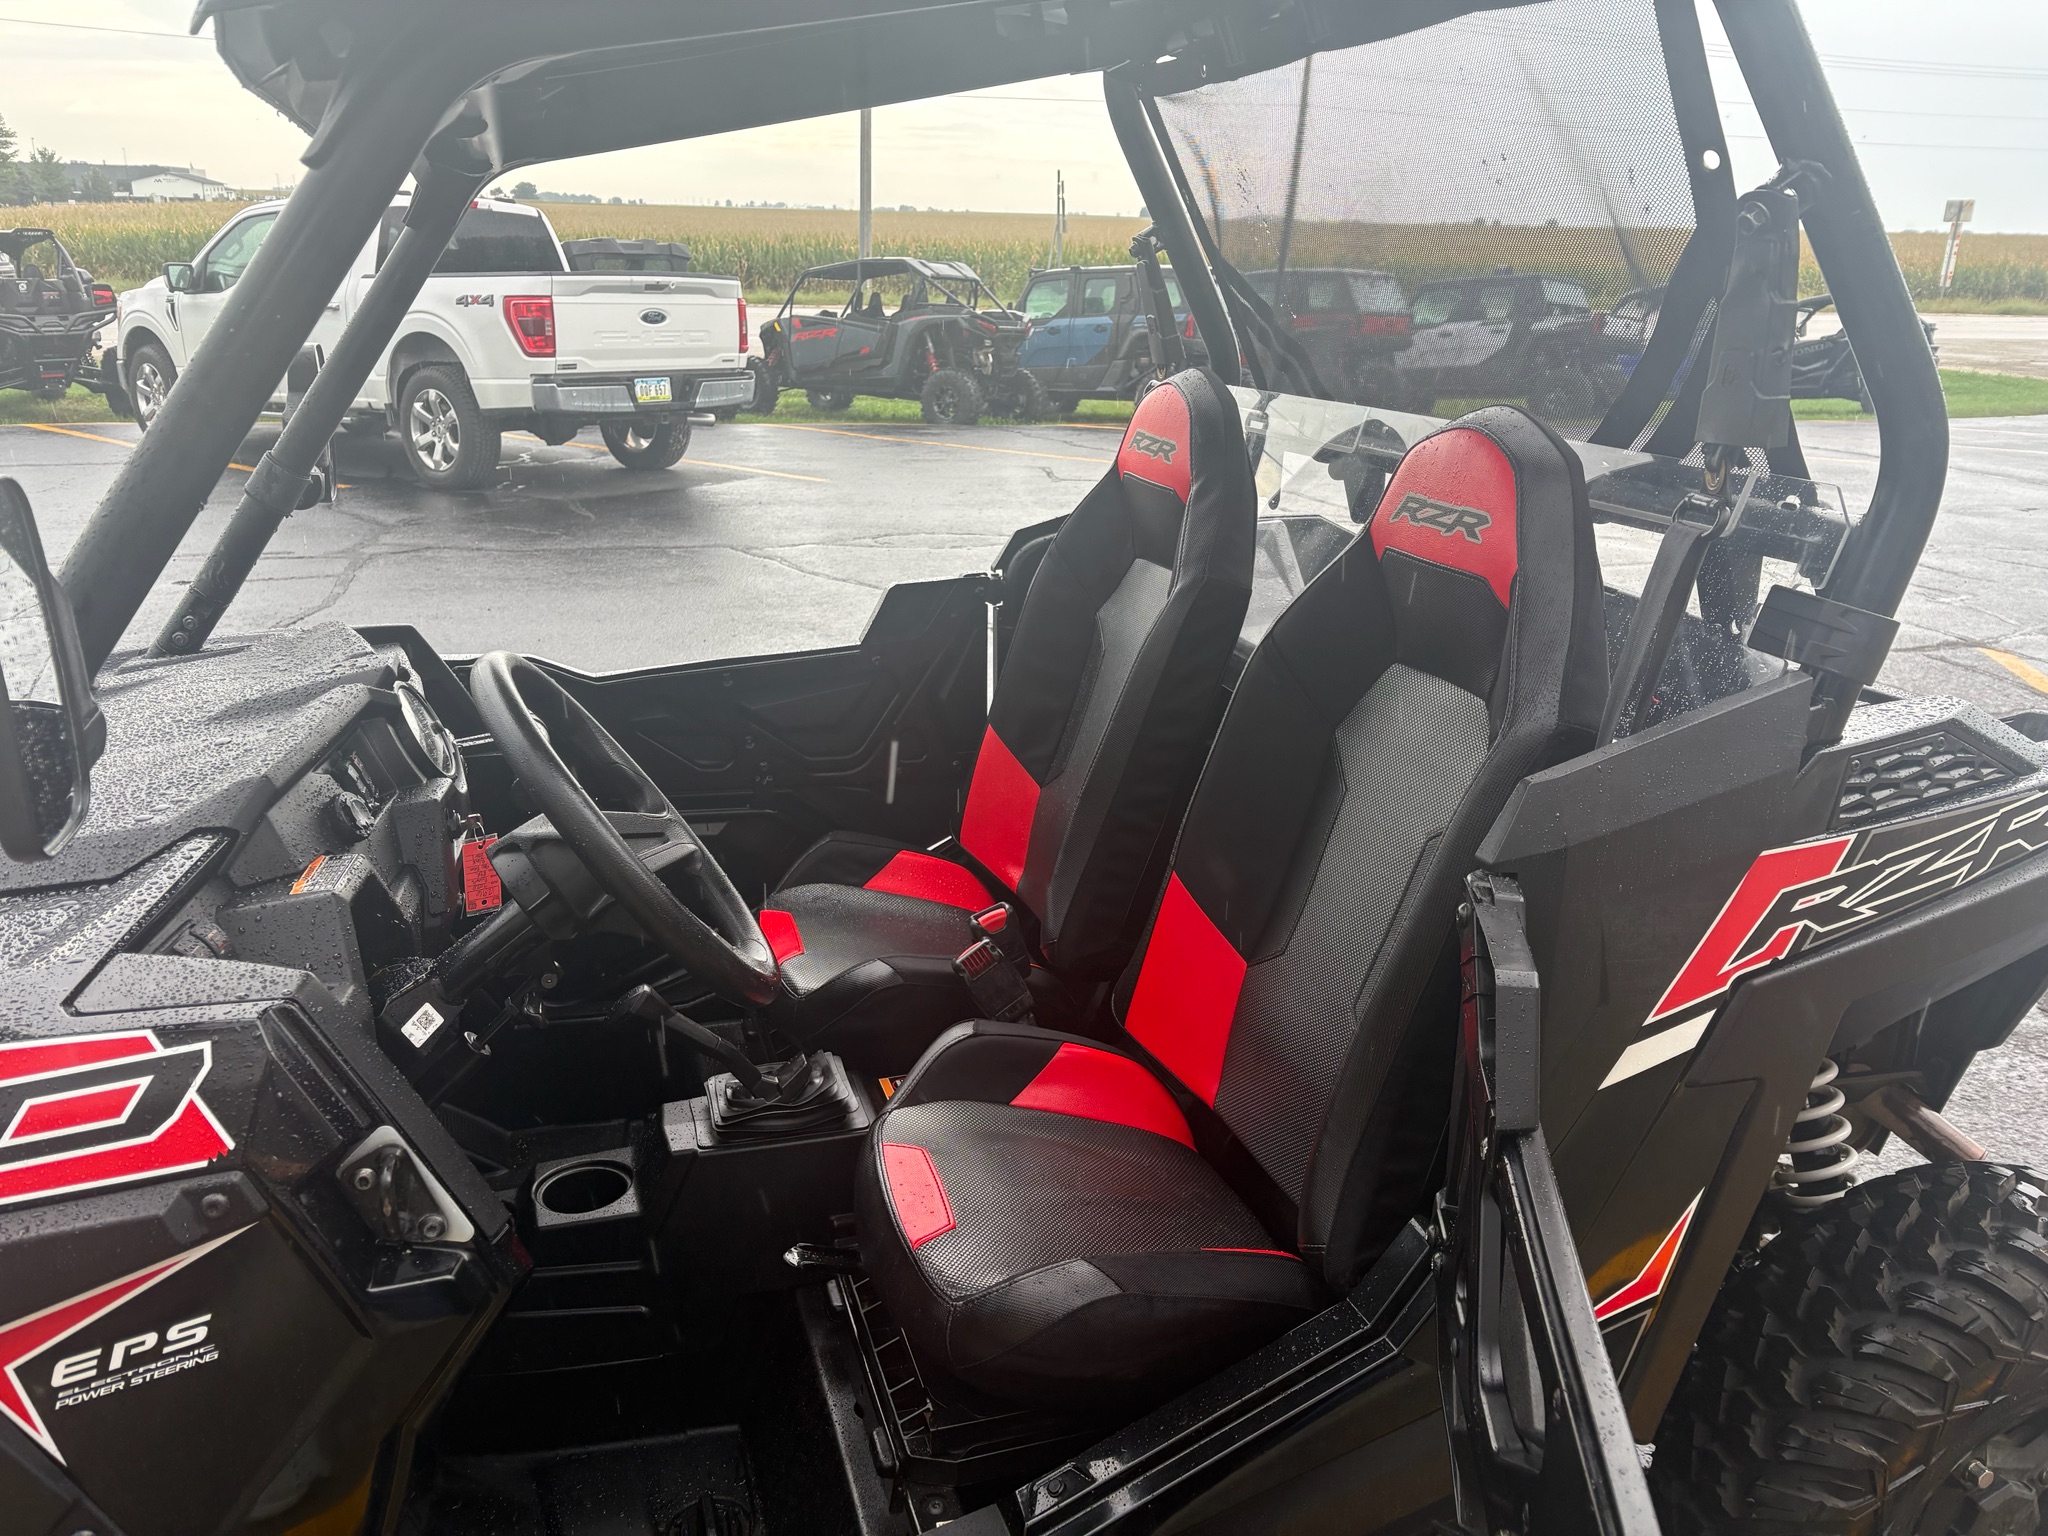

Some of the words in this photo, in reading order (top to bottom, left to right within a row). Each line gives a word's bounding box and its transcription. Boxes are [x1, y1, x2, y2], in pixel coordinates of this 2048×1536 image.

[791, 327, 838, 343] RZR
[1794, 341, 1834, 356] ONDA
[1127, 428, 1178, 465] RZR
[1390, 490, 1492, 545] RZR
[51, 1313, 212, 1388] EPS
[58, 1343, 215, 1399] ELECTRONIC
[55, 1381, 126, 1411] POWER
[129, 1350, 219, 1388] STEERING
